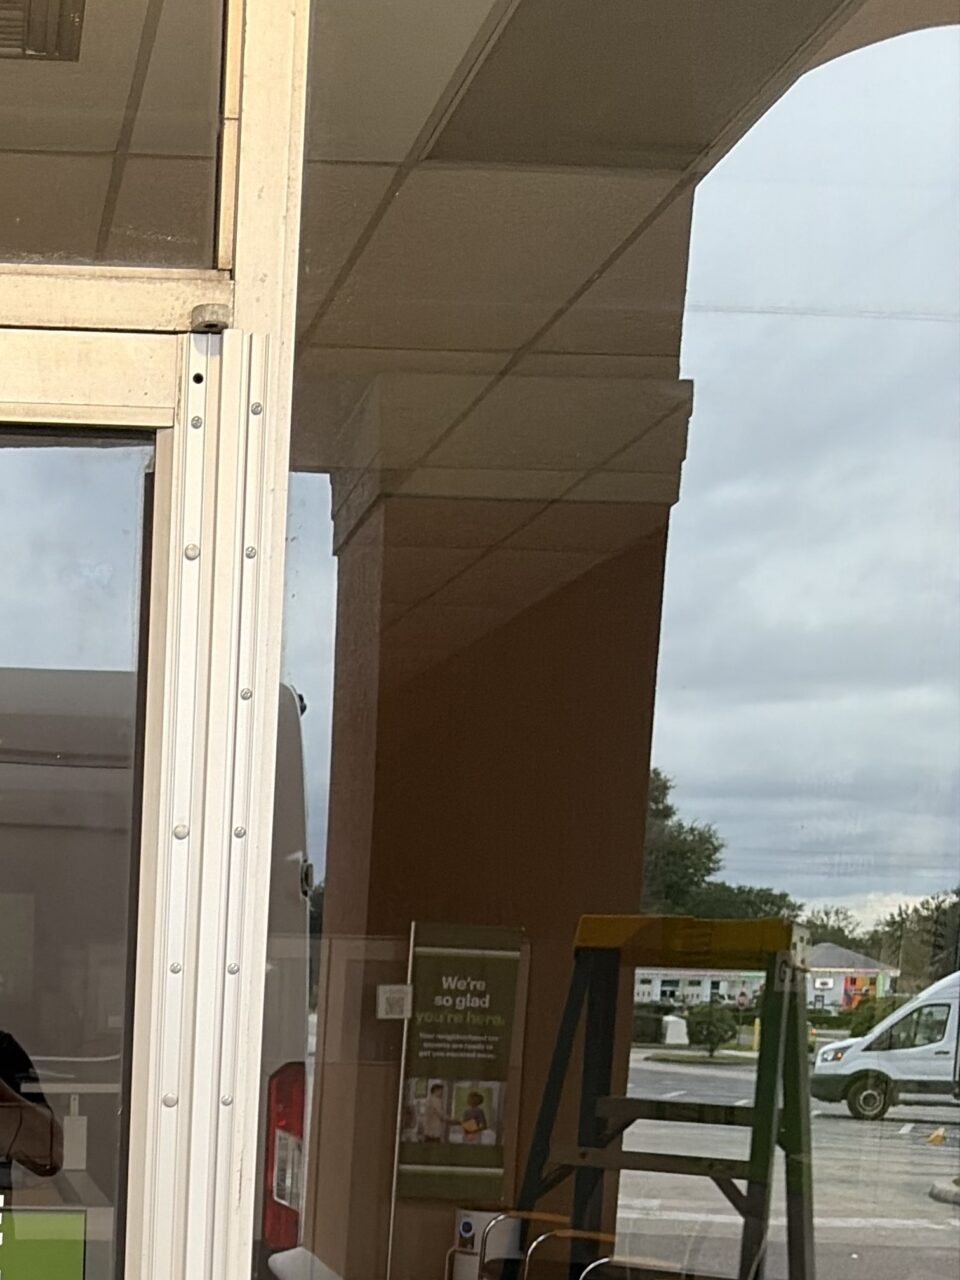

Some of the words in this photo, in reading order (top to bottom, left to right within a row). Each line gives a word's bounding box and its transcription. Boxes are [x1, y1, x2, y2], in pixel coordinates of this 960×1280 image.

[441, 975, 486, 991] We're
[434, 995, 453, 1007] so
[455, 993, 491, 1010] glad
[416, 1011, 464, 1025] you're
